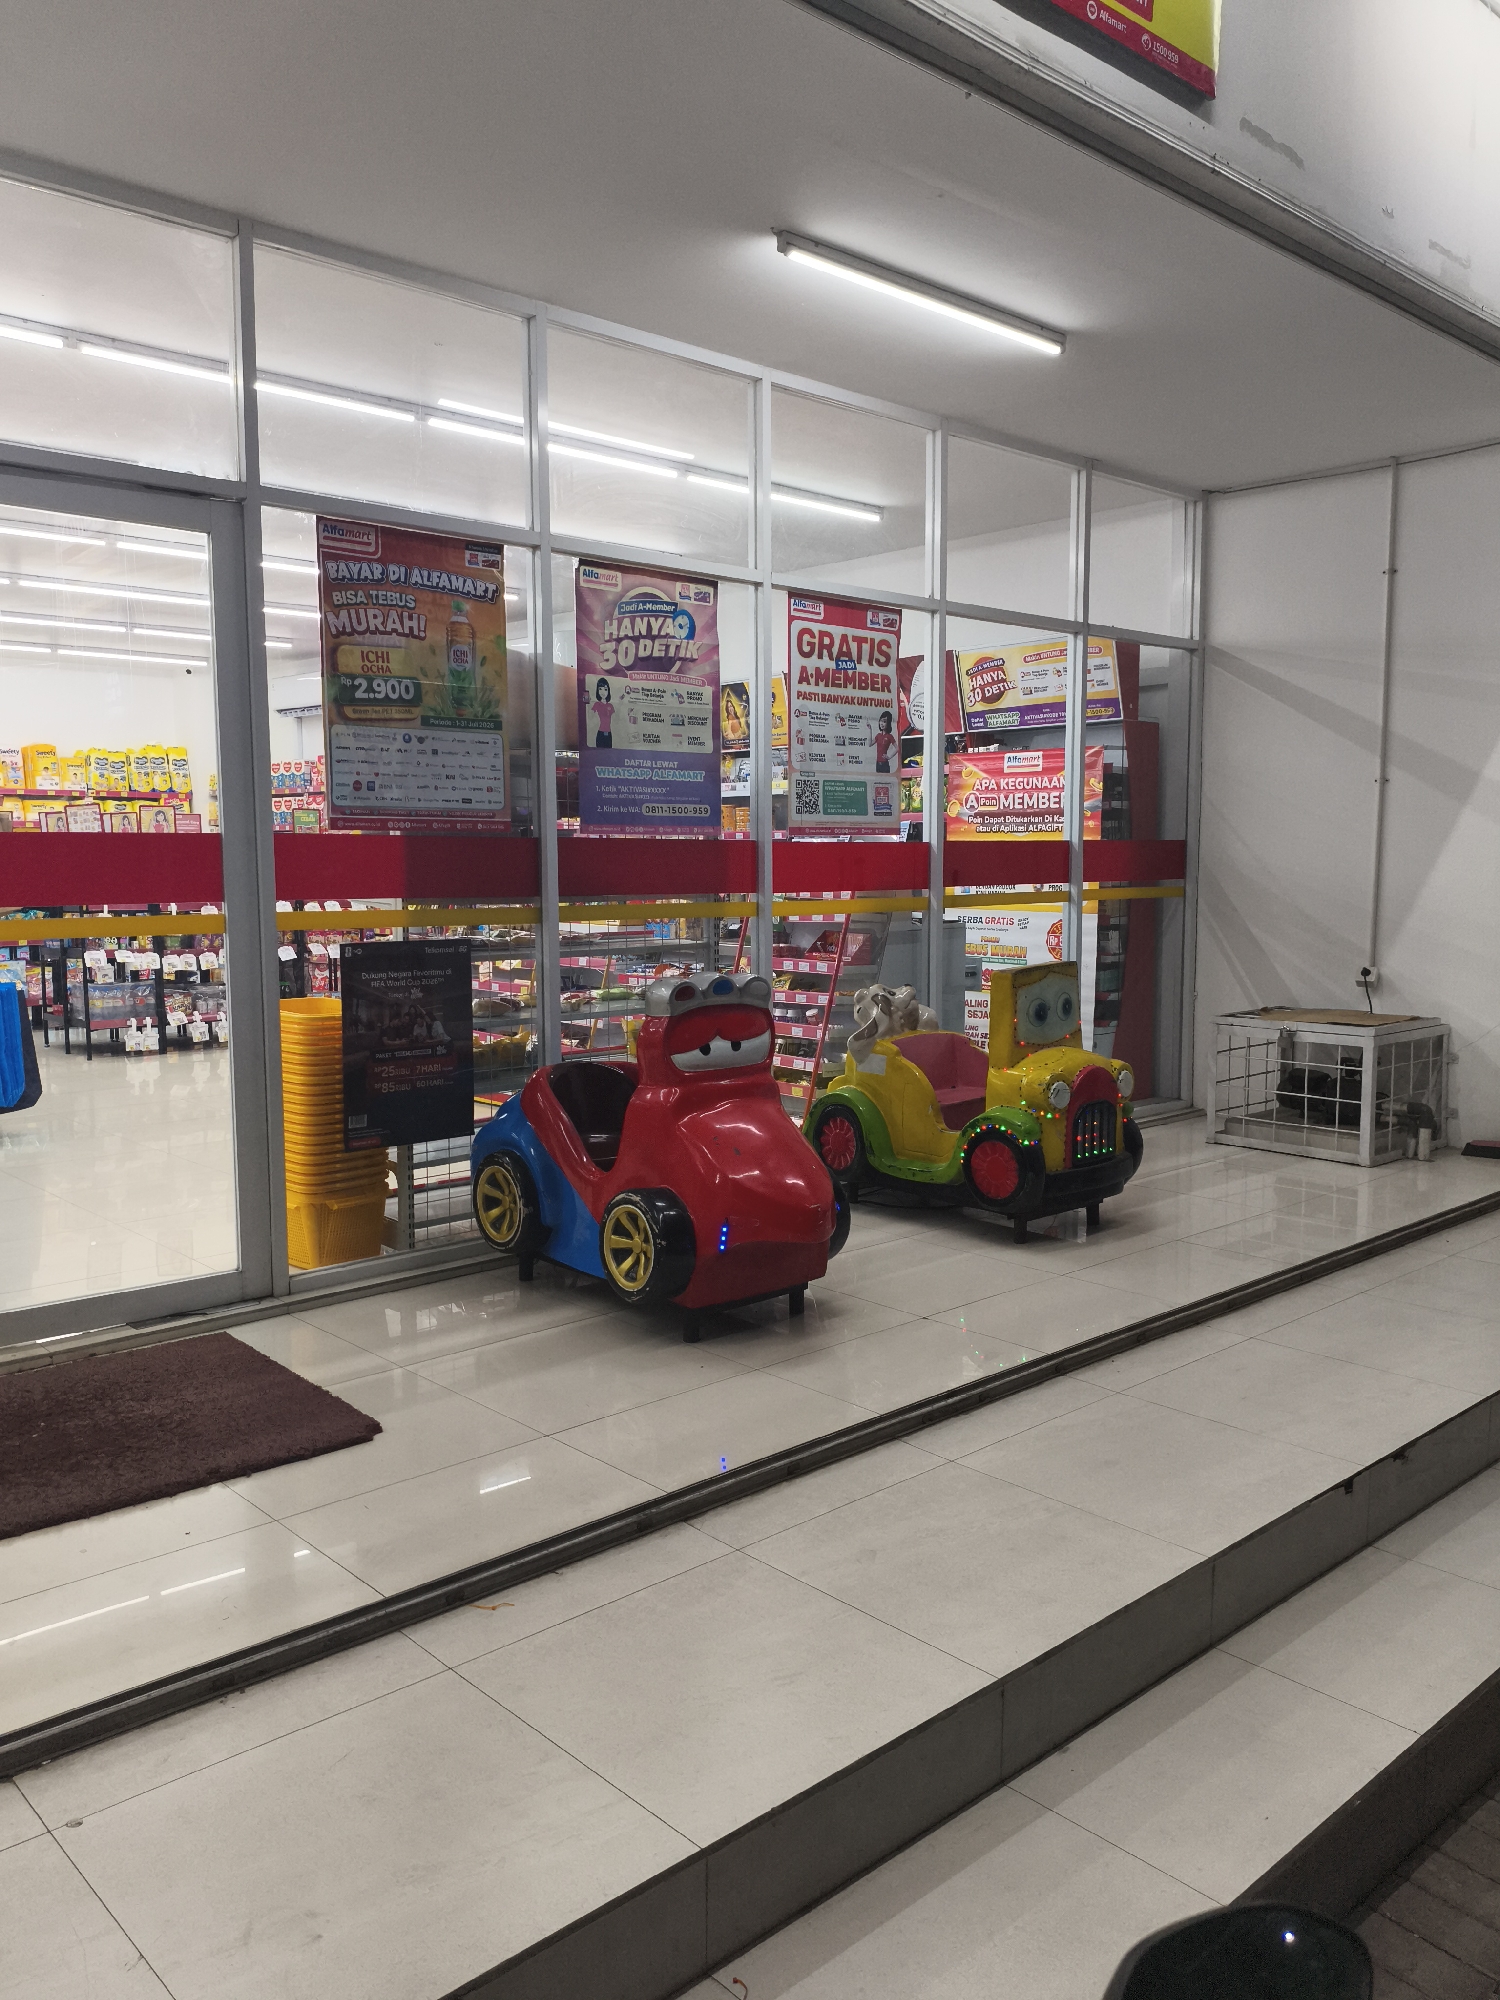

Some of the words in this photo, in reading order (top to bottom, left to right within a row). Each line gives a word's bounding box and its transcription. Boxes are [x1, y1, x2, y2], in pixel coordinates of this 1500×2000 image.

[322, 523, 373, 541] Alfamart
[582, 568, 619, 583] Alfamart
[326, 561, 385, 584] BAYAR
[388, 564, 409, 586] DI
[410, 568, 500, 604] ALFAMART
[332, 589, 370, 608] BISA
[369, 590, 416, 610] TEBUS
[792, 599, 822, 611] Alfamart
[620, 604, 637, 612] Jadi
[638, 601, 676, 612] A-Member
[326, 608, 427, 641] MURAH!
[604, 616, 675, 641] HANYA
[796, 627, 892, 668] GRATIS
[360, 649, 390, 664] ICHI
[452, 648, 468, 659] ICHI
[599, 639, 636, 670] 30
[637, 639, 703, 661] DETIK
[452, 657, 469, 665] OCHA
[838, 661, 856, 670] JADI
[360, 664, 392, 674] OCHA
[968, 669, 1007, 690] HANYA
[341, 676, 352, 687] Rp
[353, 677, 415, 700] 2.900
[966, 688, 984, 707] 30
[983, 679, 1018, 698] DETIK
[796, 690, 820, 702] PASTI
[820, 693, 856, 705] BANYAK
[856, 697, 893, 709] UNTUNG!
[984, 711, 1020, 721] WHATSAPP
[987, 719, 1020, 728] ALFAMART
[35, 748, 56, 757] Sweety
[624, 758, 651, 767] DAFTAR
[652, 760, 679, 769] LEWAT
[1006, 754, 1041, 764] Alfamart
[595, 766, 651, 779] WHATSAPP
[652, 770, 706, 782] ALFAMART
[973, 777, 998, 791] APA
[966, 794, 979, 809] A
[980, 797, 997, 806] Poin
[603, 805, 620, 813] Kirim
[645, 805, 709, 815] 0811-1500-959
[968, 815, 983, 824] Poin
[984, 815, 1005, 825] Dapat
[1005, 815, 1043, 823] Ditukarkan
[1044, 814, 1052, 823] Di
[976, 825, 991, 833] atau
[992, 824, 1000, 832] di
[999, 824, 1027, 834] Aplikasi
[1027, 824, 1064, 832] ALFAGIFT
[957, 915, 984, 925] SERBA
[1049, 935, 1058, 946] Rp
[425, 946, 455, 954] Telkomsel
[965, 943, 989, 956] EBUS
[990, 945, 1028, 958] MURAH
[361, 972, 387, 980] Dukung
[388, 970, 412, 979] Negara
[413, 969, 445, 977] Favoritmu
[386, 979, 406, 987] World
[406, 979, 421, 987] Cup
[964, 999, 989, 1008] ALING
[421, 1063, 442, 1073] HARI
